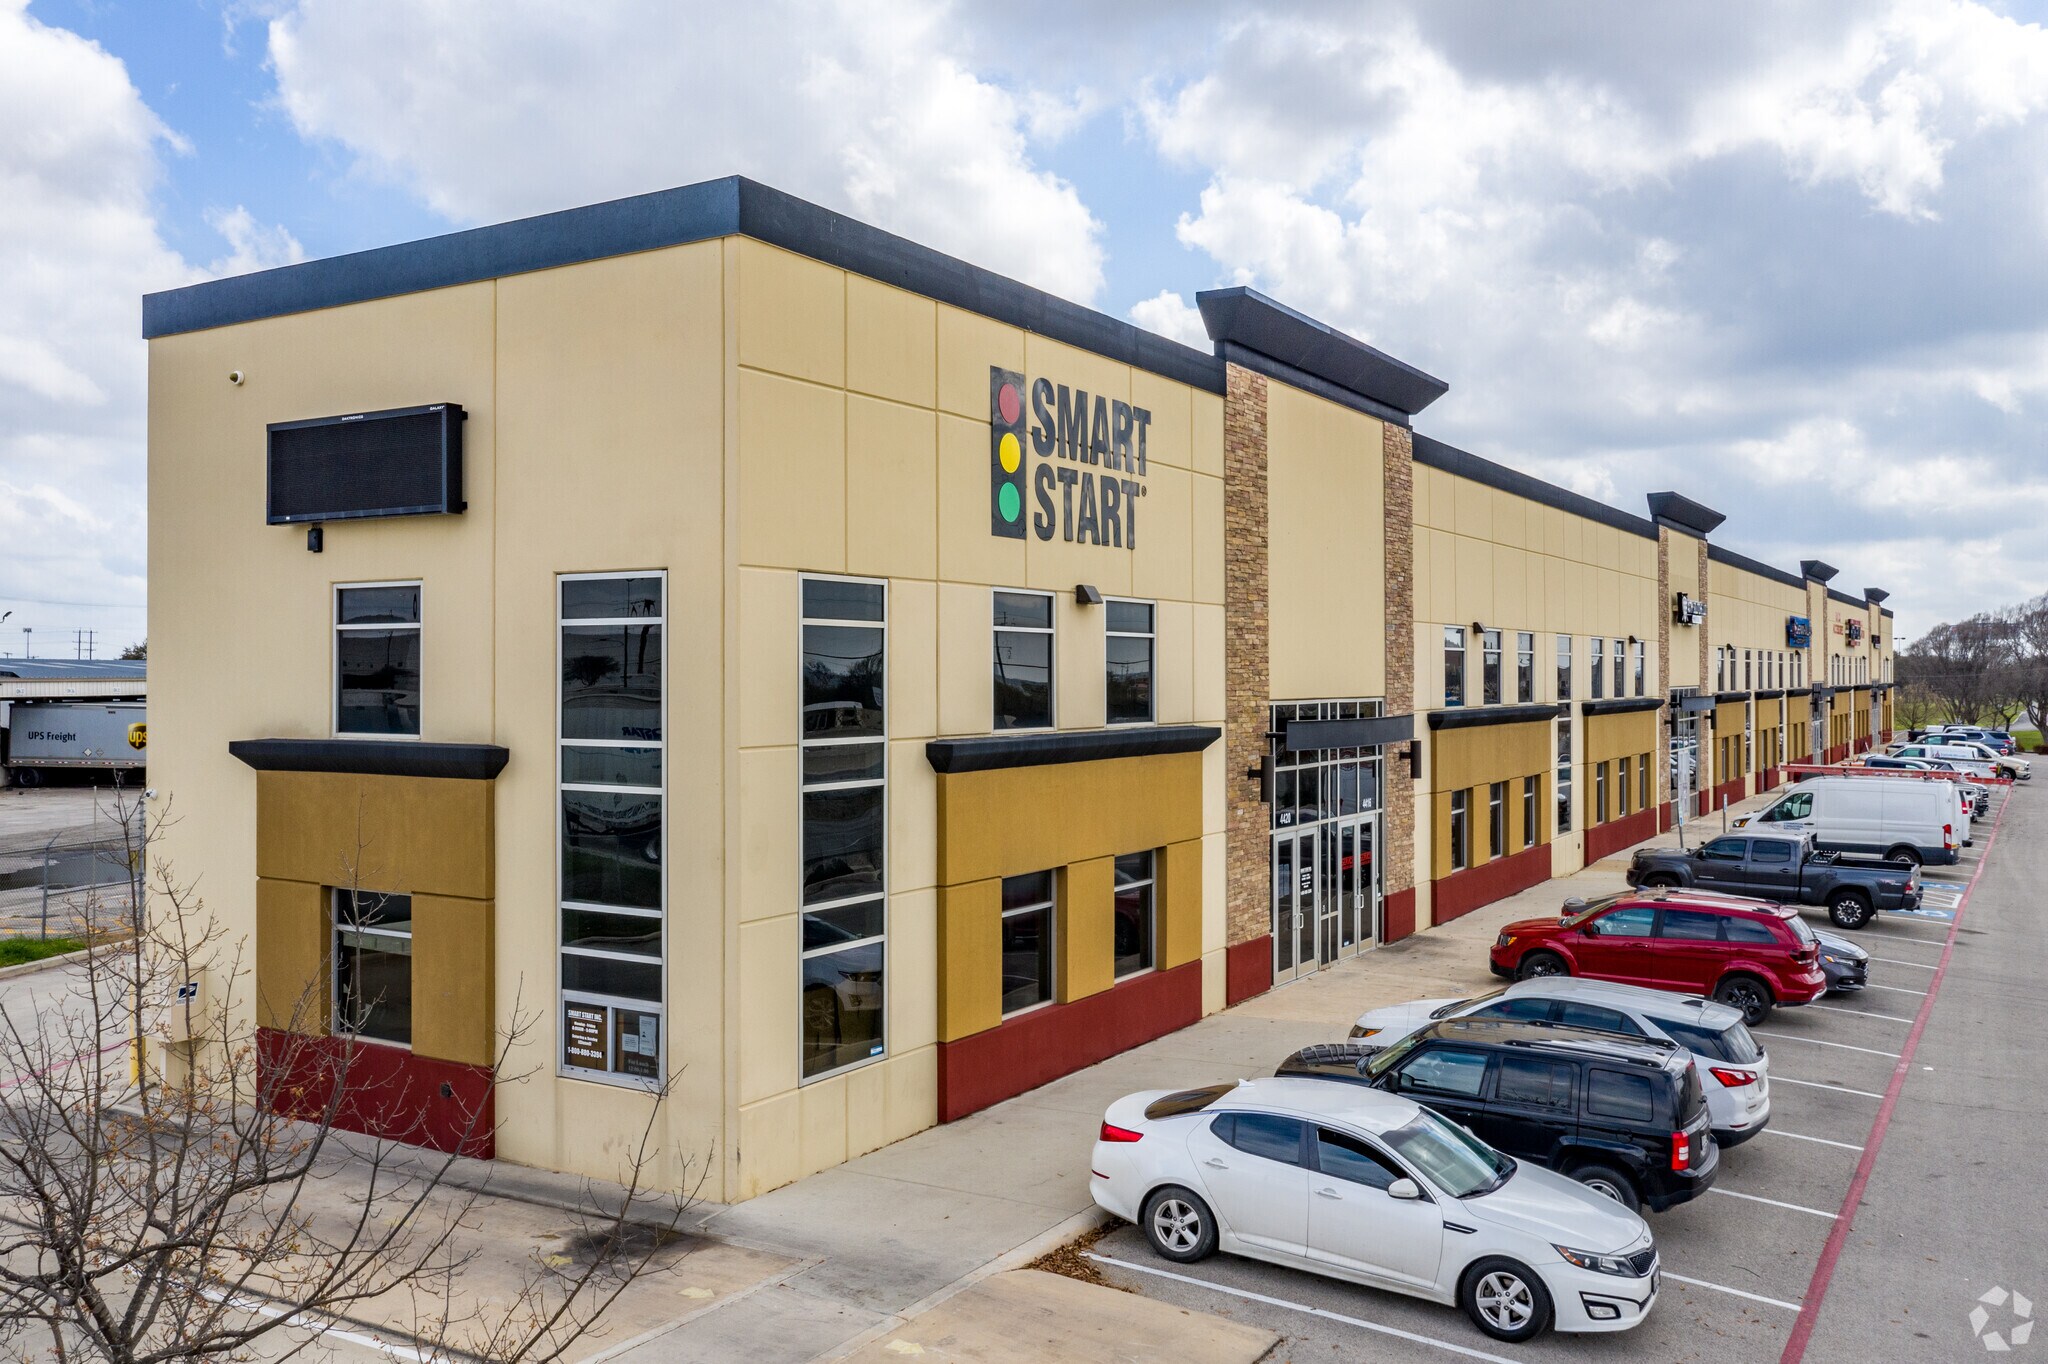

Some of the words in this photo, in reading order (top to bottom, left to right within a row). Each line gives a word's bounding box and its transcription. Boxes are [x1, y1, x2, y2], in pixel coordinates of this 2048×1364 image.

[1032, 378, 1151, 476] SMART
[28, 731, 44, 740] UPS
[47, 732, 76, 743] Freight
[1280, 813, 1291, 824] 4420
[582, 1011, 593, 1019] START
